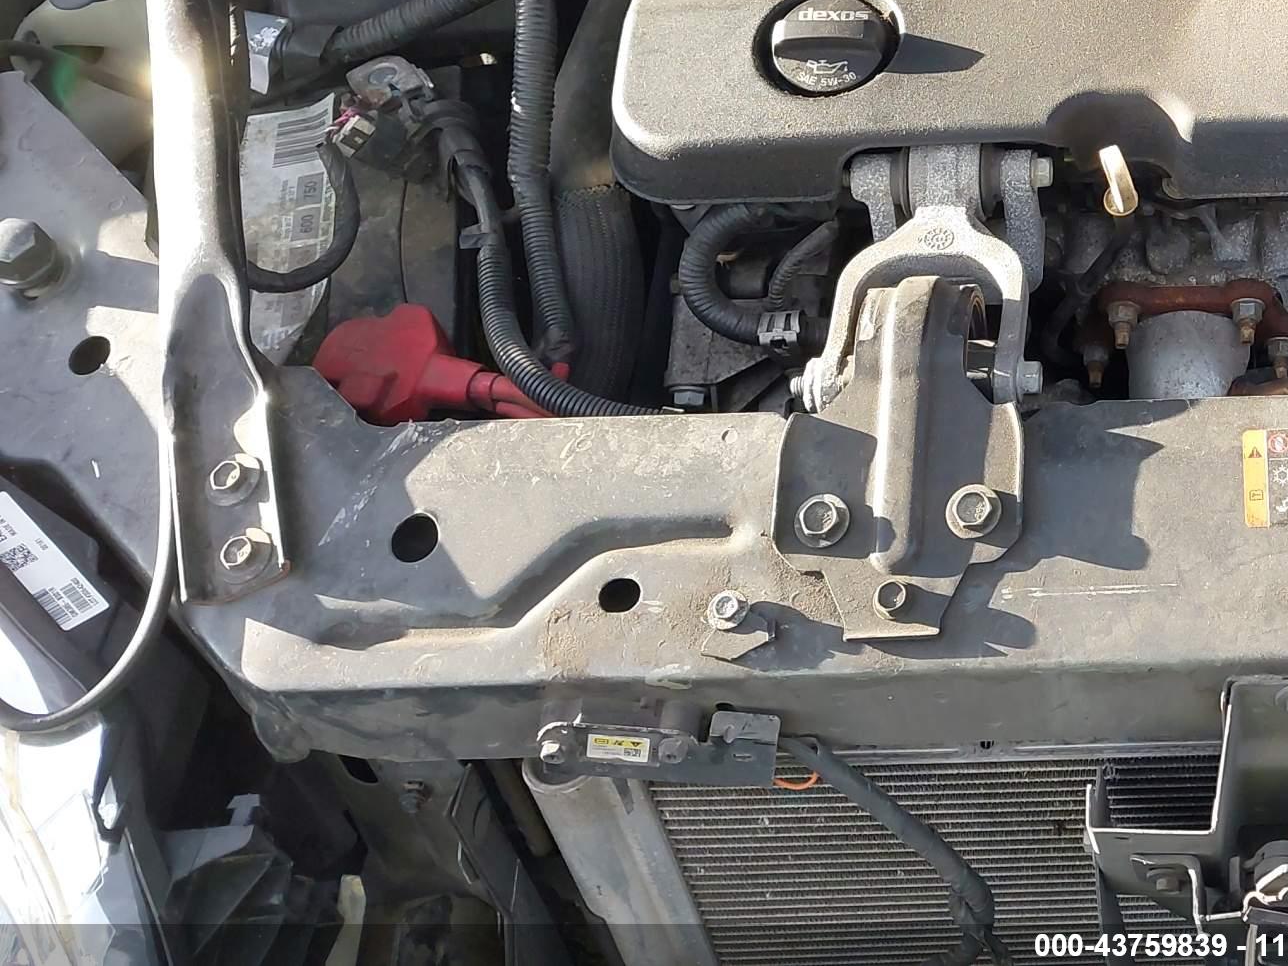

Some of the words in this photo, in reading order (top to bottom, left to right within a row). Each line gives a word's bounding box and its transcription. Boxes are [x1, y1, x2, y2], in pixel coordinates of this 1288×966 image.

[798, 7, 872, 21] dexos
[796, 72, 818, 85] SAE
[820, 71, 857, 86] 5W-30
[303, 180, 318, 201] 750
[300, 214, 314, 234] 600
